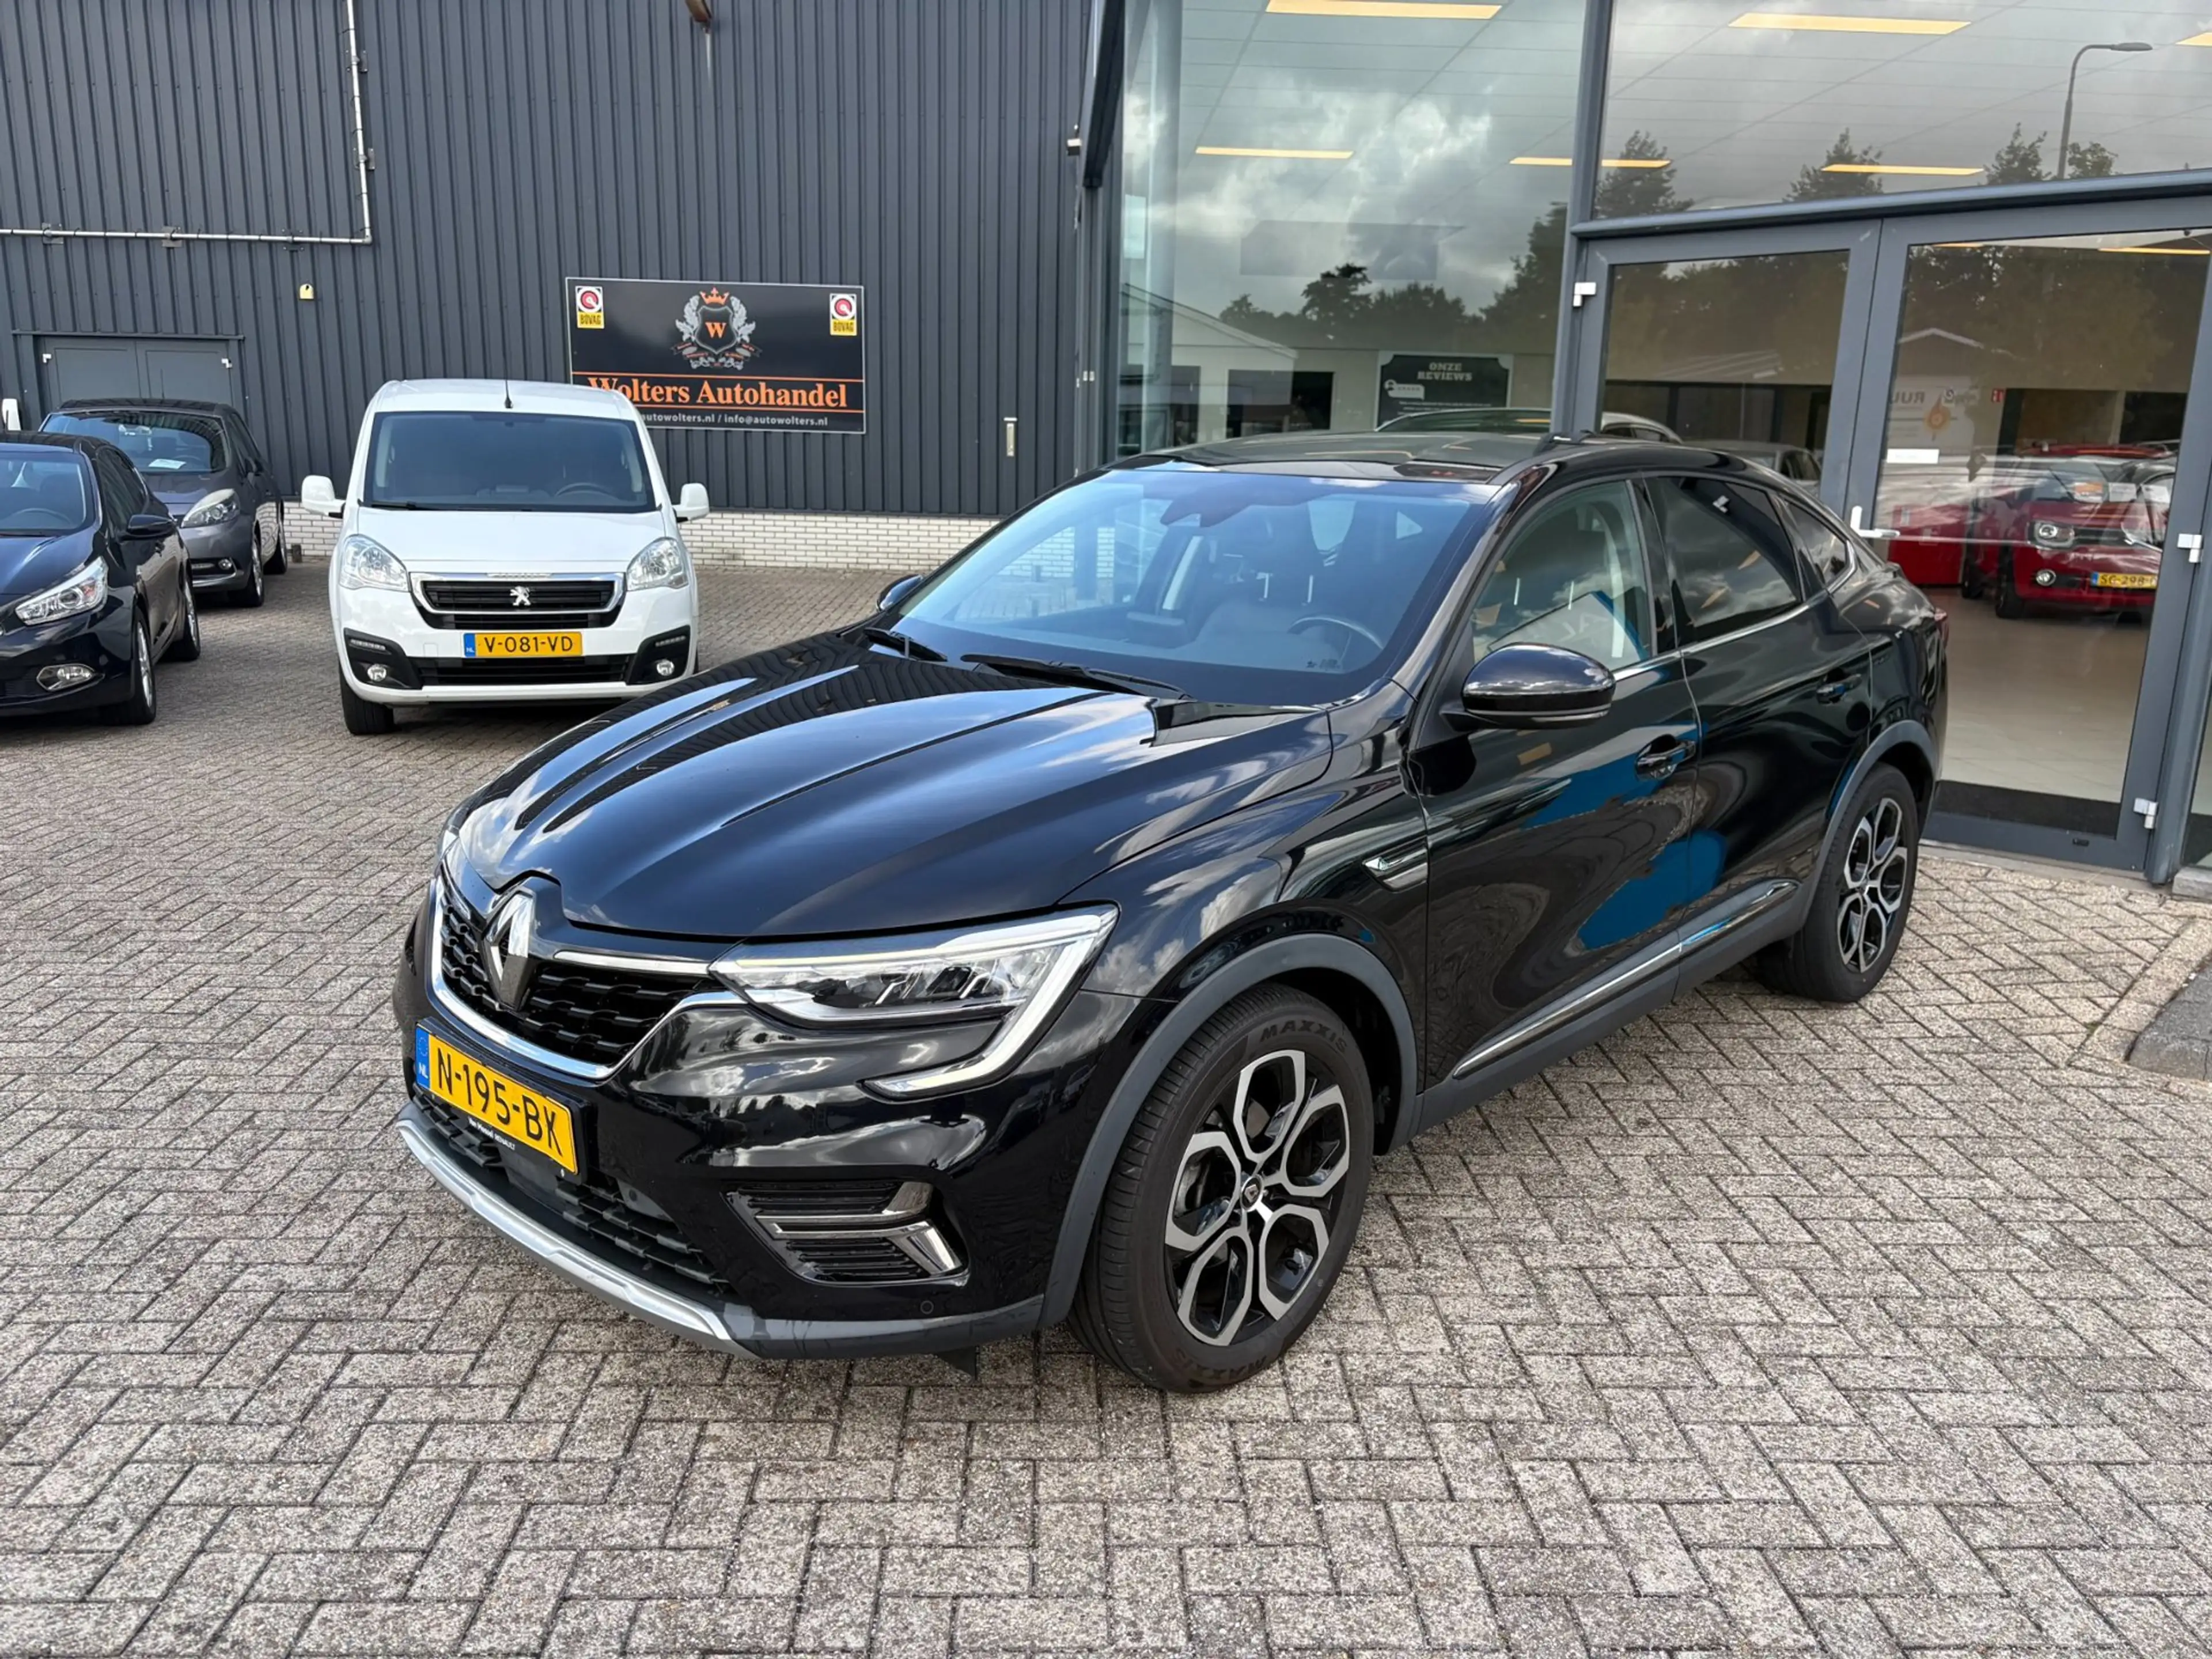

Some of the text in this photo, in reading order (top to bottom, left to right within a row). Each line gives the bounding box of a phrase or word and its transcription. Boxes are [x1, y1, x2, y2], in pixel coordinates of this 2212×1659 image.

[580, 313, 602, 325] BOVAG
[704, 321, 727, 339] W
[833, 321, 854, 332] BOVAG
[1429, 361, 1462, 371] ONZE
[1417, 370, 1472, 381] REVIEWS
[588, 377, 847, 407] Wolters Autohandel
[724, 414, 828, 426] info@autowolters.nl
[484, 636, 573, 653] V-081-VD
[1260, 1019, 1348, 1054] MAXXIS
[418, 1061, 429, 1080] NL
